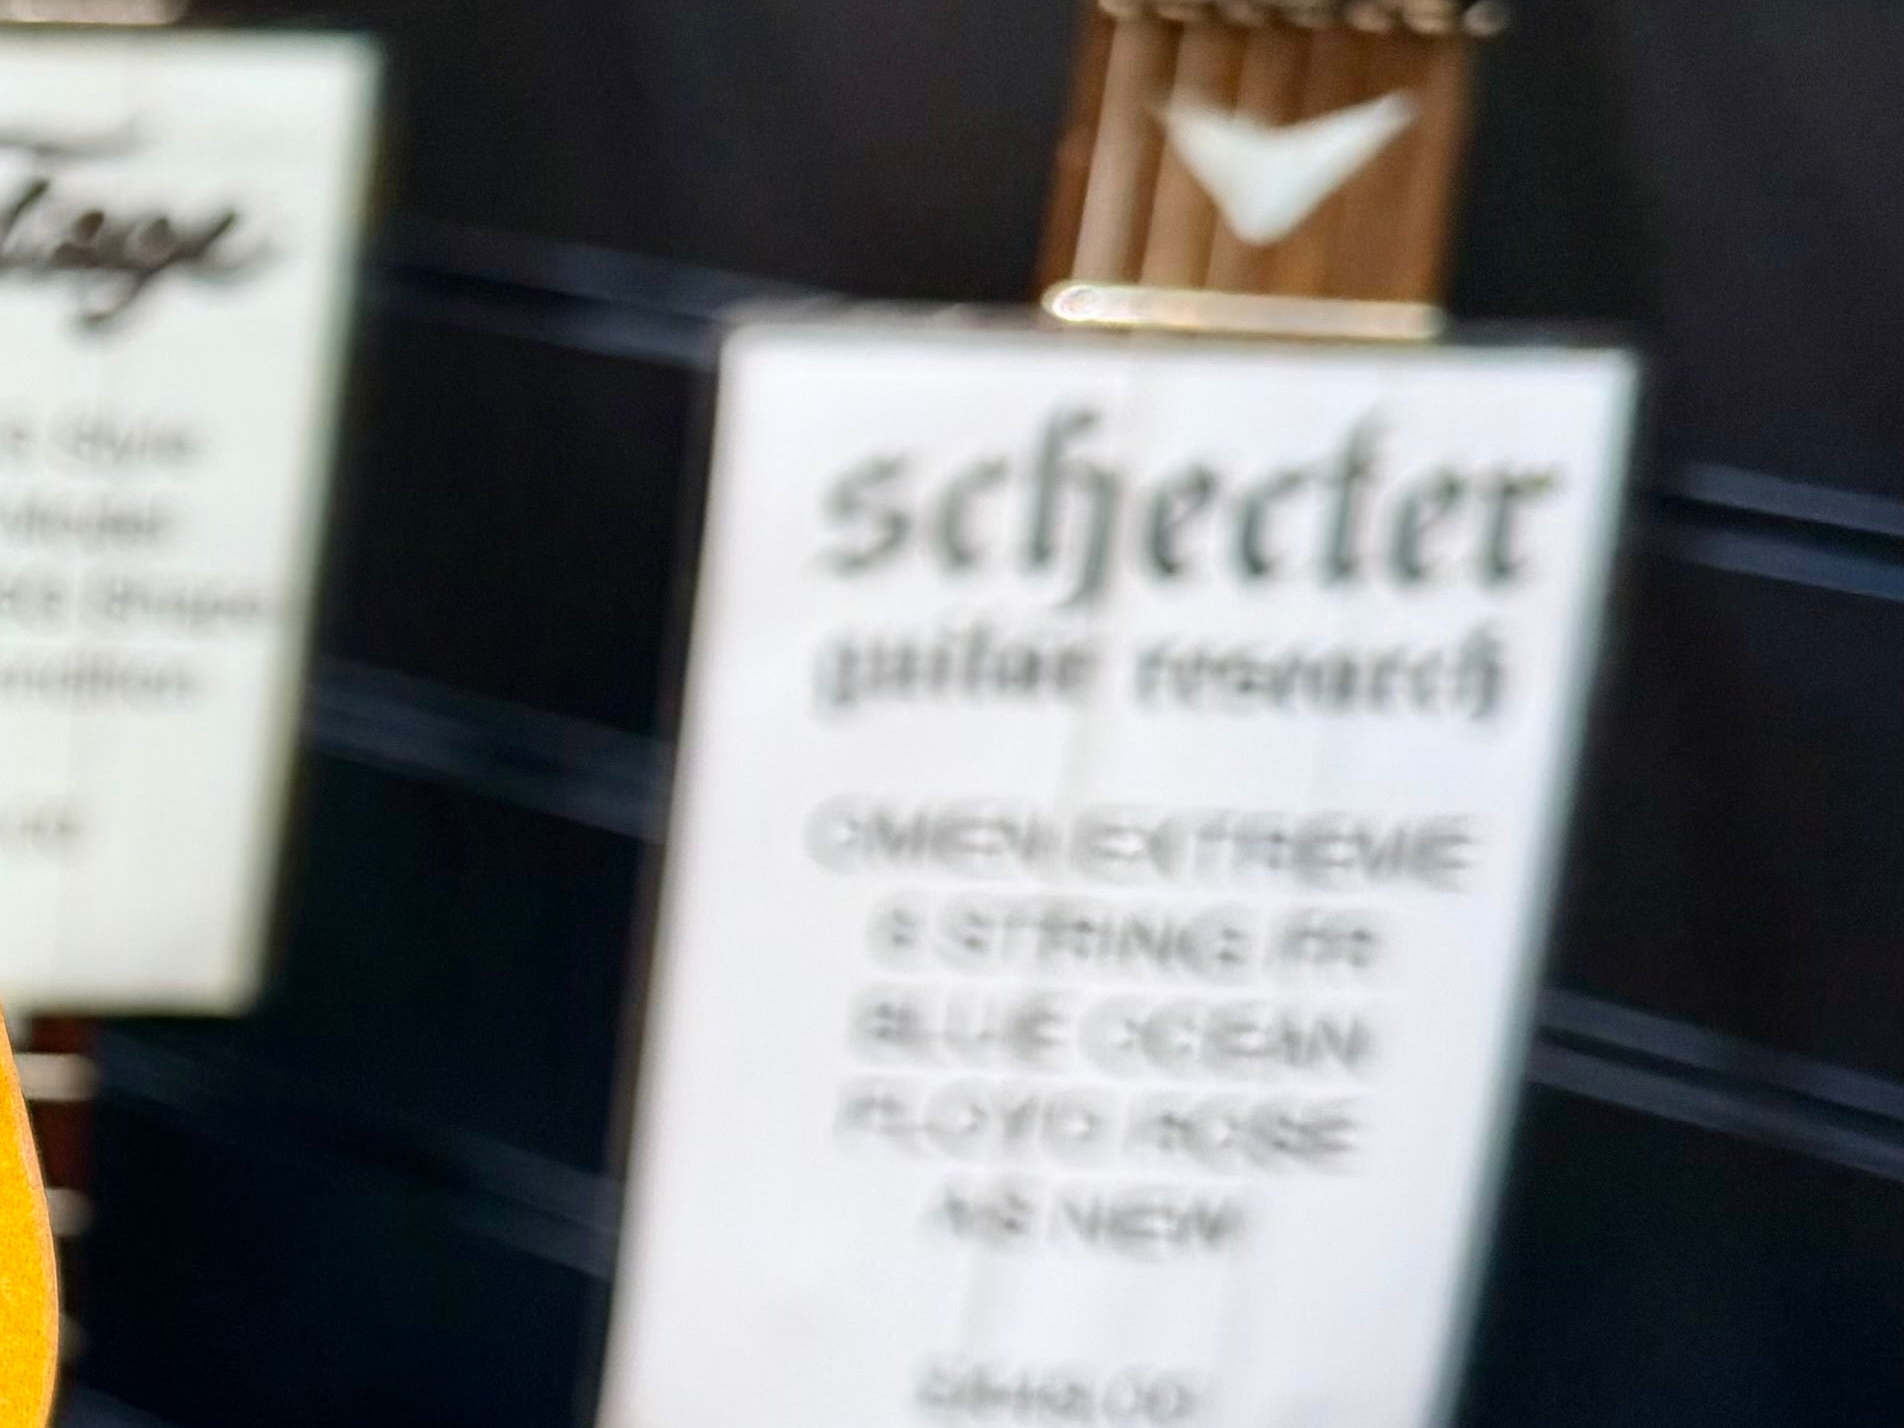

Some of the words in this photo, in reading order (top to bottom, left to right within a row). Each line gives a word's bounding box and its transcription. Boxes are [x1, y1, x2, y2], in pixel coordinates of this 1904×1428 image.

[818, 400, 1569, 610] schecter
[815, 614, 1096, 725] guitar
[1135, 621, 1515, 725] research
[1070, 808, 1475, 887] EXTREME
[940, 898, 1252, 980] STRING
[853, 986, 1068, 1065] BLUE
[1081, 995, 1376, 1076] OCEAN
[838, 1079, 1118, 1160] FLOYD
[1129, 1091, 1364, 1170] ROSE
[1049, 1184, 1255, 1257] NEW
